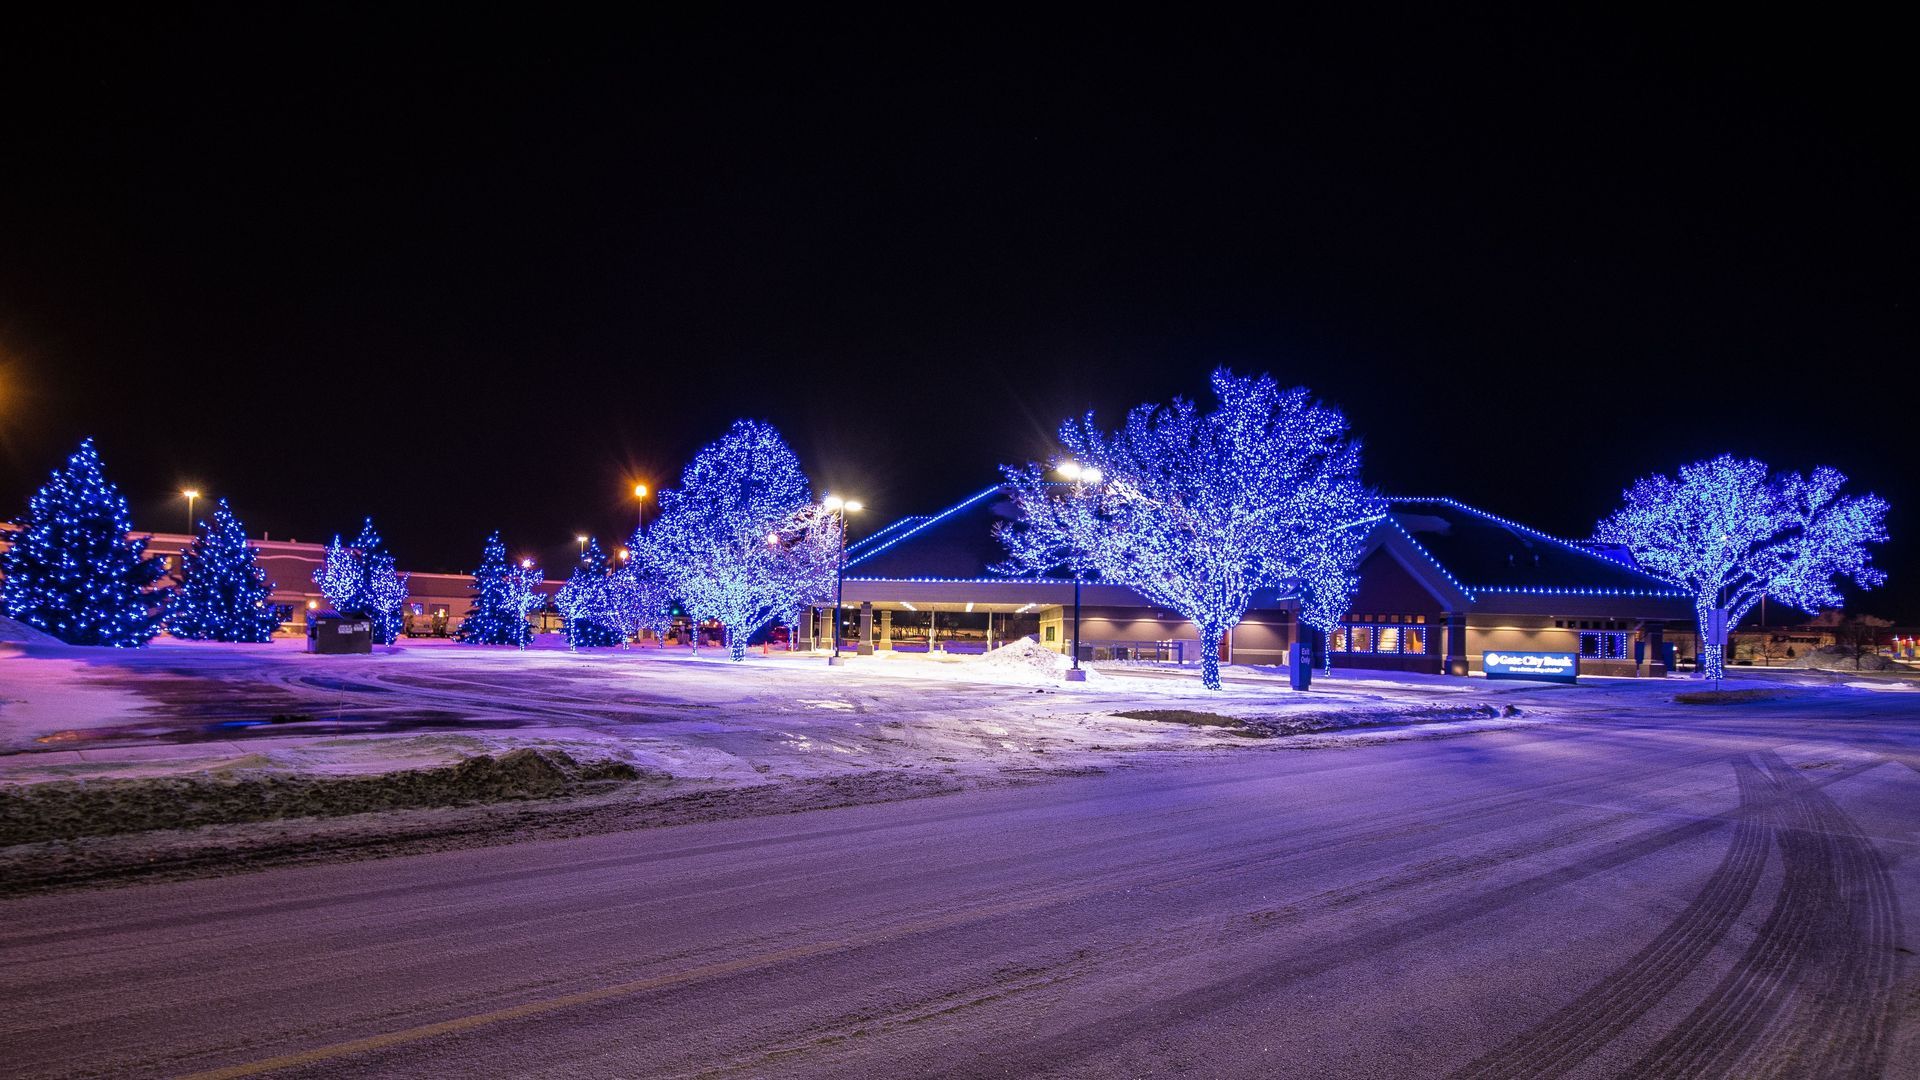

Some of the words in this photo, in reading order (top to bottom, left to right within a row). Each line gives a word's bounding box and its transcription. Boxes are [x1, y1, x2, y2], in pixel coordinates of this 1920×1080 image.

[1300, 656, 1310, 665] Only
[1499, 655, 1523, 665] Gate
[1522, 655, 1544, 668] City
[1543, 656, 1572, 666] Bank
